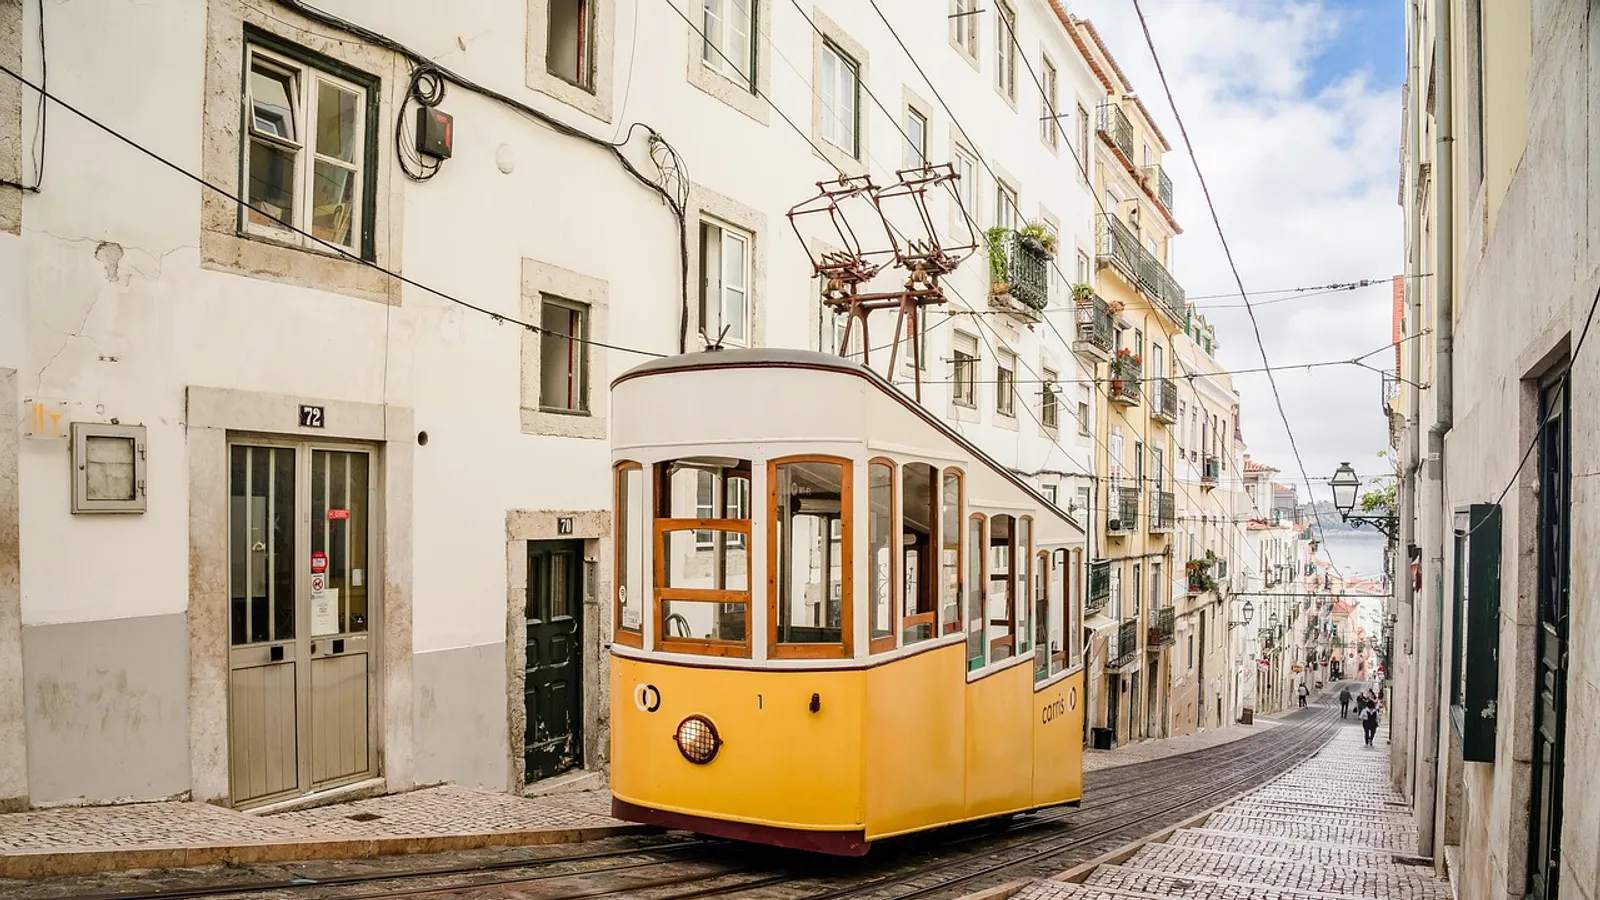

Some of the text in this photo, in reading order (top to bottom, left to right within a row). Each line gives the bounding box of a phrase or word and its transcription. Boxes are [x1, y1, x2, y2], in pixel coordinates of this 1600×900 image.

[303, 406, 321, 427] 72
[560, 518, 571, 533] 70
[757, 693, 763, 710] 1
[1042, 692, 1065, 725] carris
